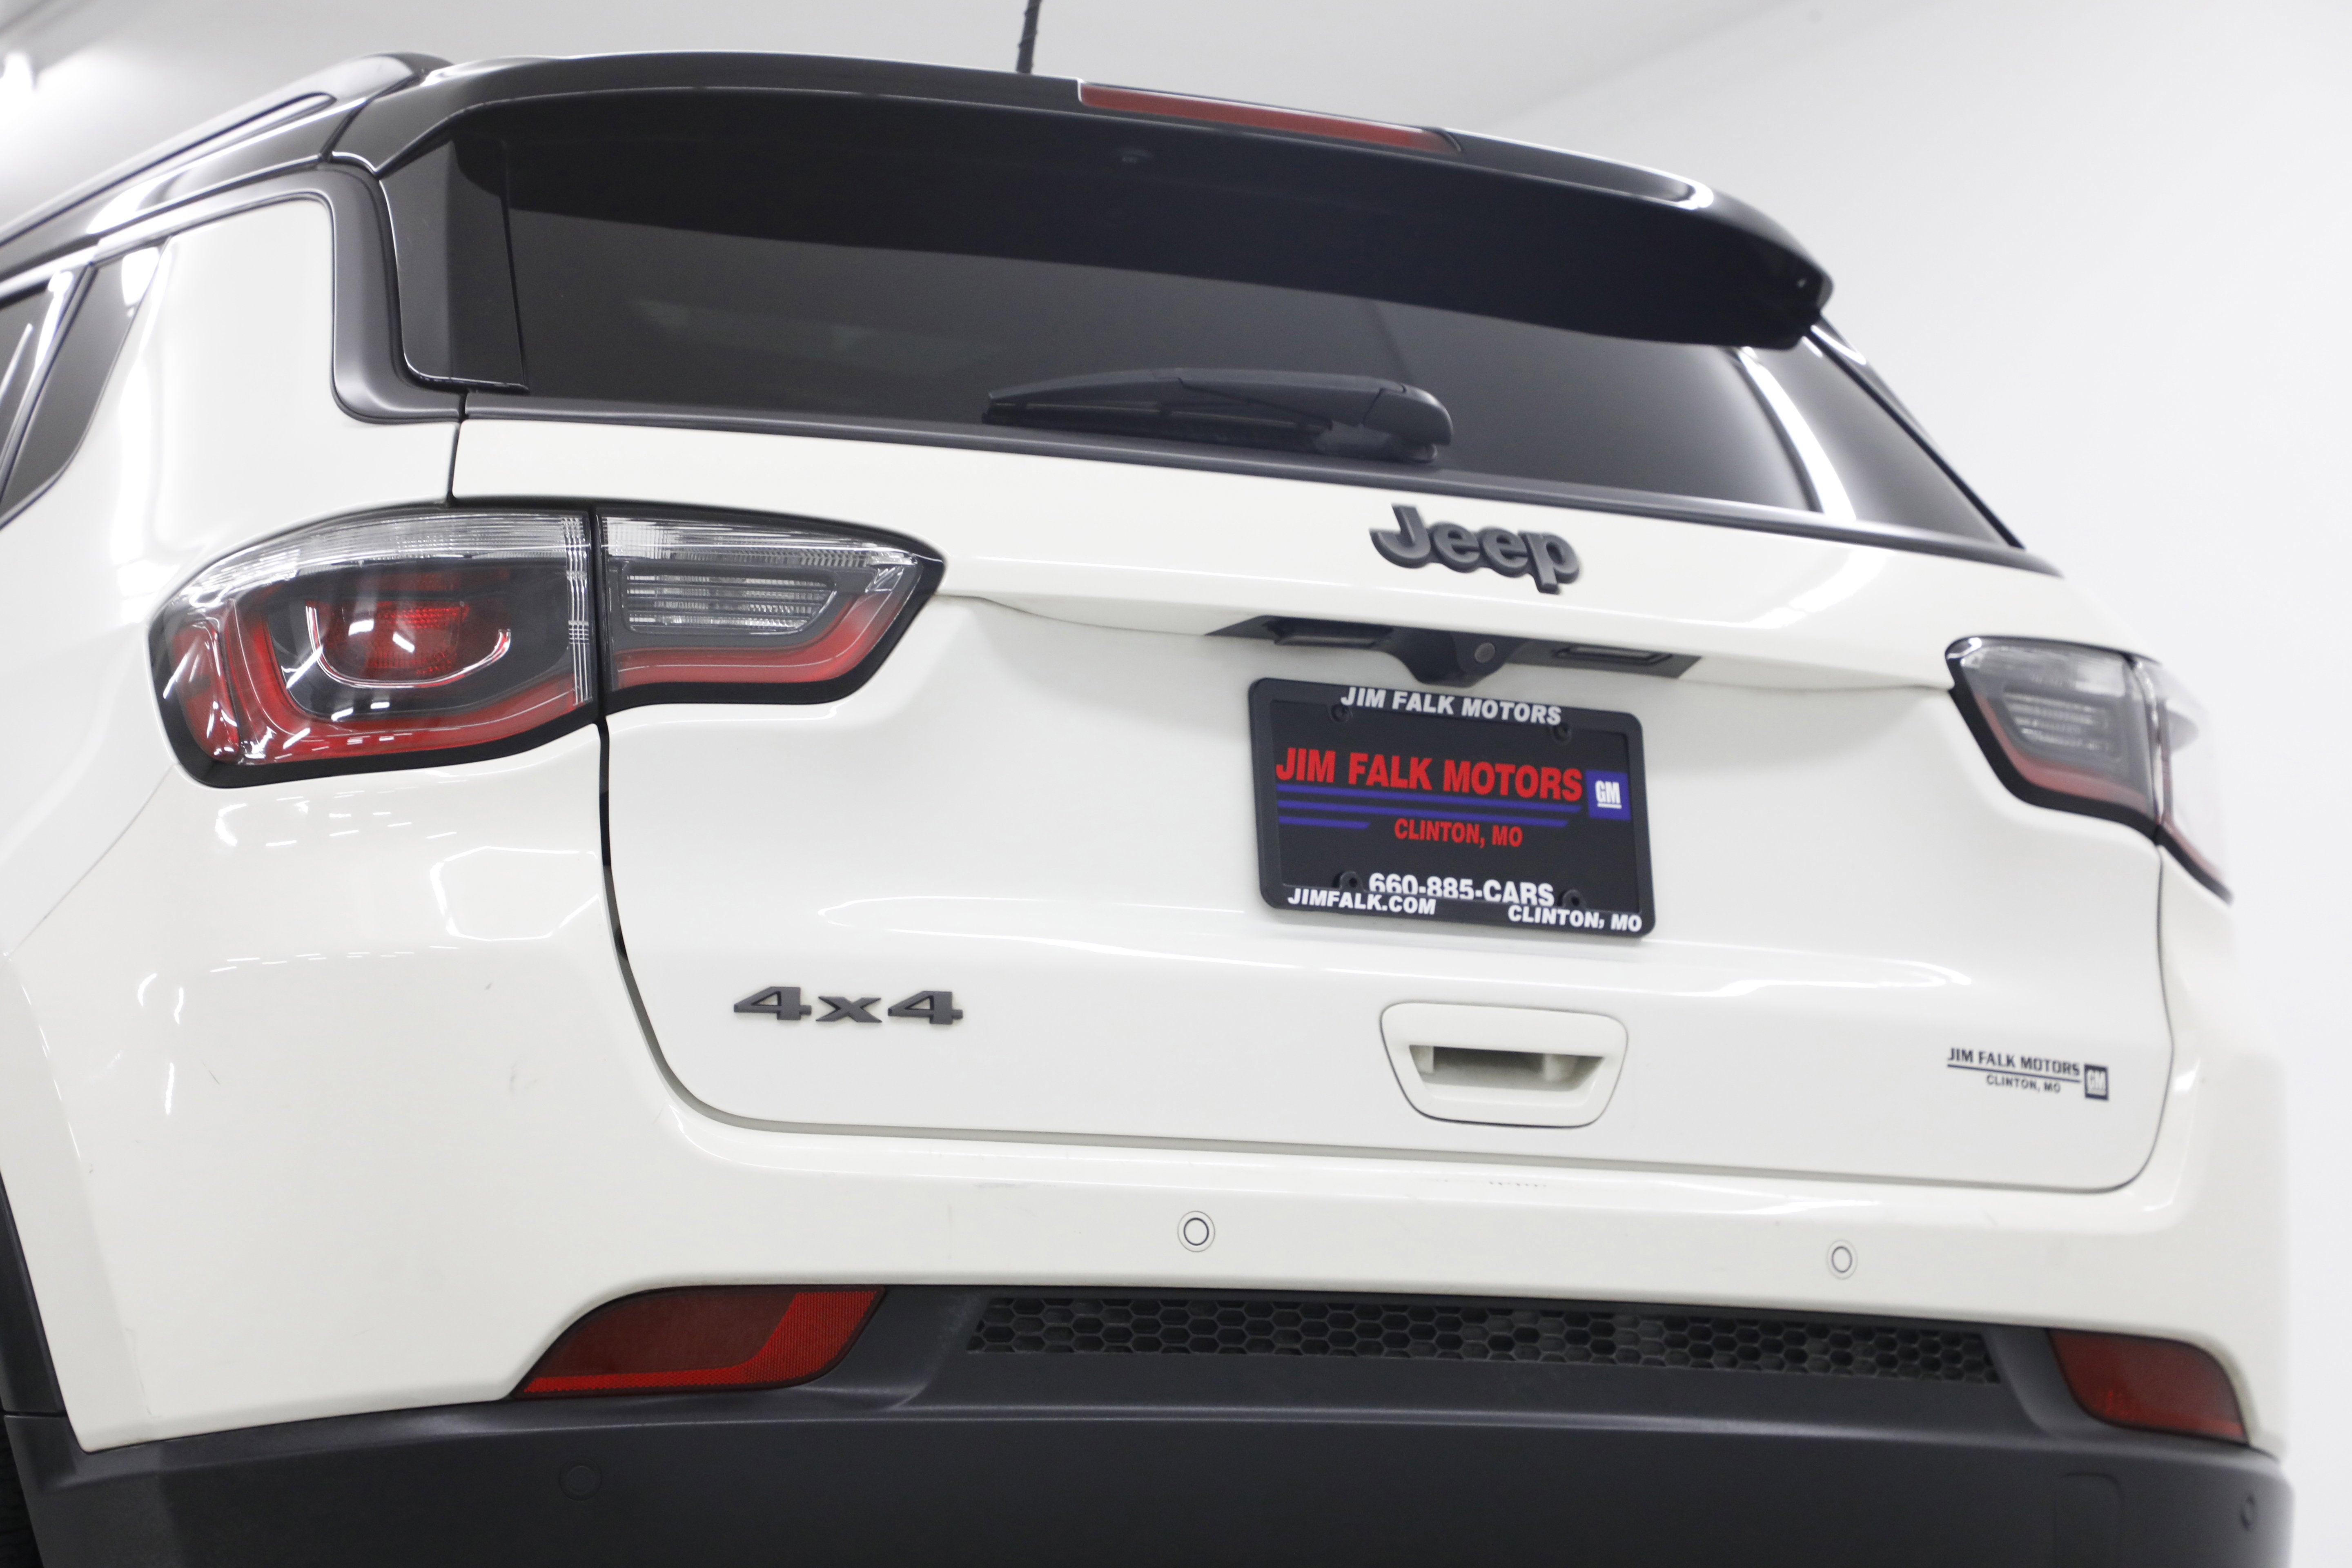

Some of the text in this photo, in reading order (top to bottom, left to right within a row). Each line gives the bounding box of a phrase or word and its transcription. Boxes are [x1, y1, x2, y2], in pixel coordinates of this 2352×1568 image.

[1369, 503, 1580, 595] Jeep
[1341, 687, 1561, 725] JIM FALK MOTORS
[1276, 747, 1582, 801] JIM FALK MOTORS
[1595, 780, 1621, 809] GM
[1394, 818, 1523, 848] CLINTON, MO
[1288, 889, 1436, 915] JIMFALK.COM
[1369, 873, 1554, 906] 660-885-CARS
[1508, 905, 1642, 932] CLINTON, MO
[734, 986, 963, 1025] 4x4
[1948, 1047, 2081, 1076] JIM FALK MOTORS
[1986, 1074, 2061, 1093] CLINTON, MO
